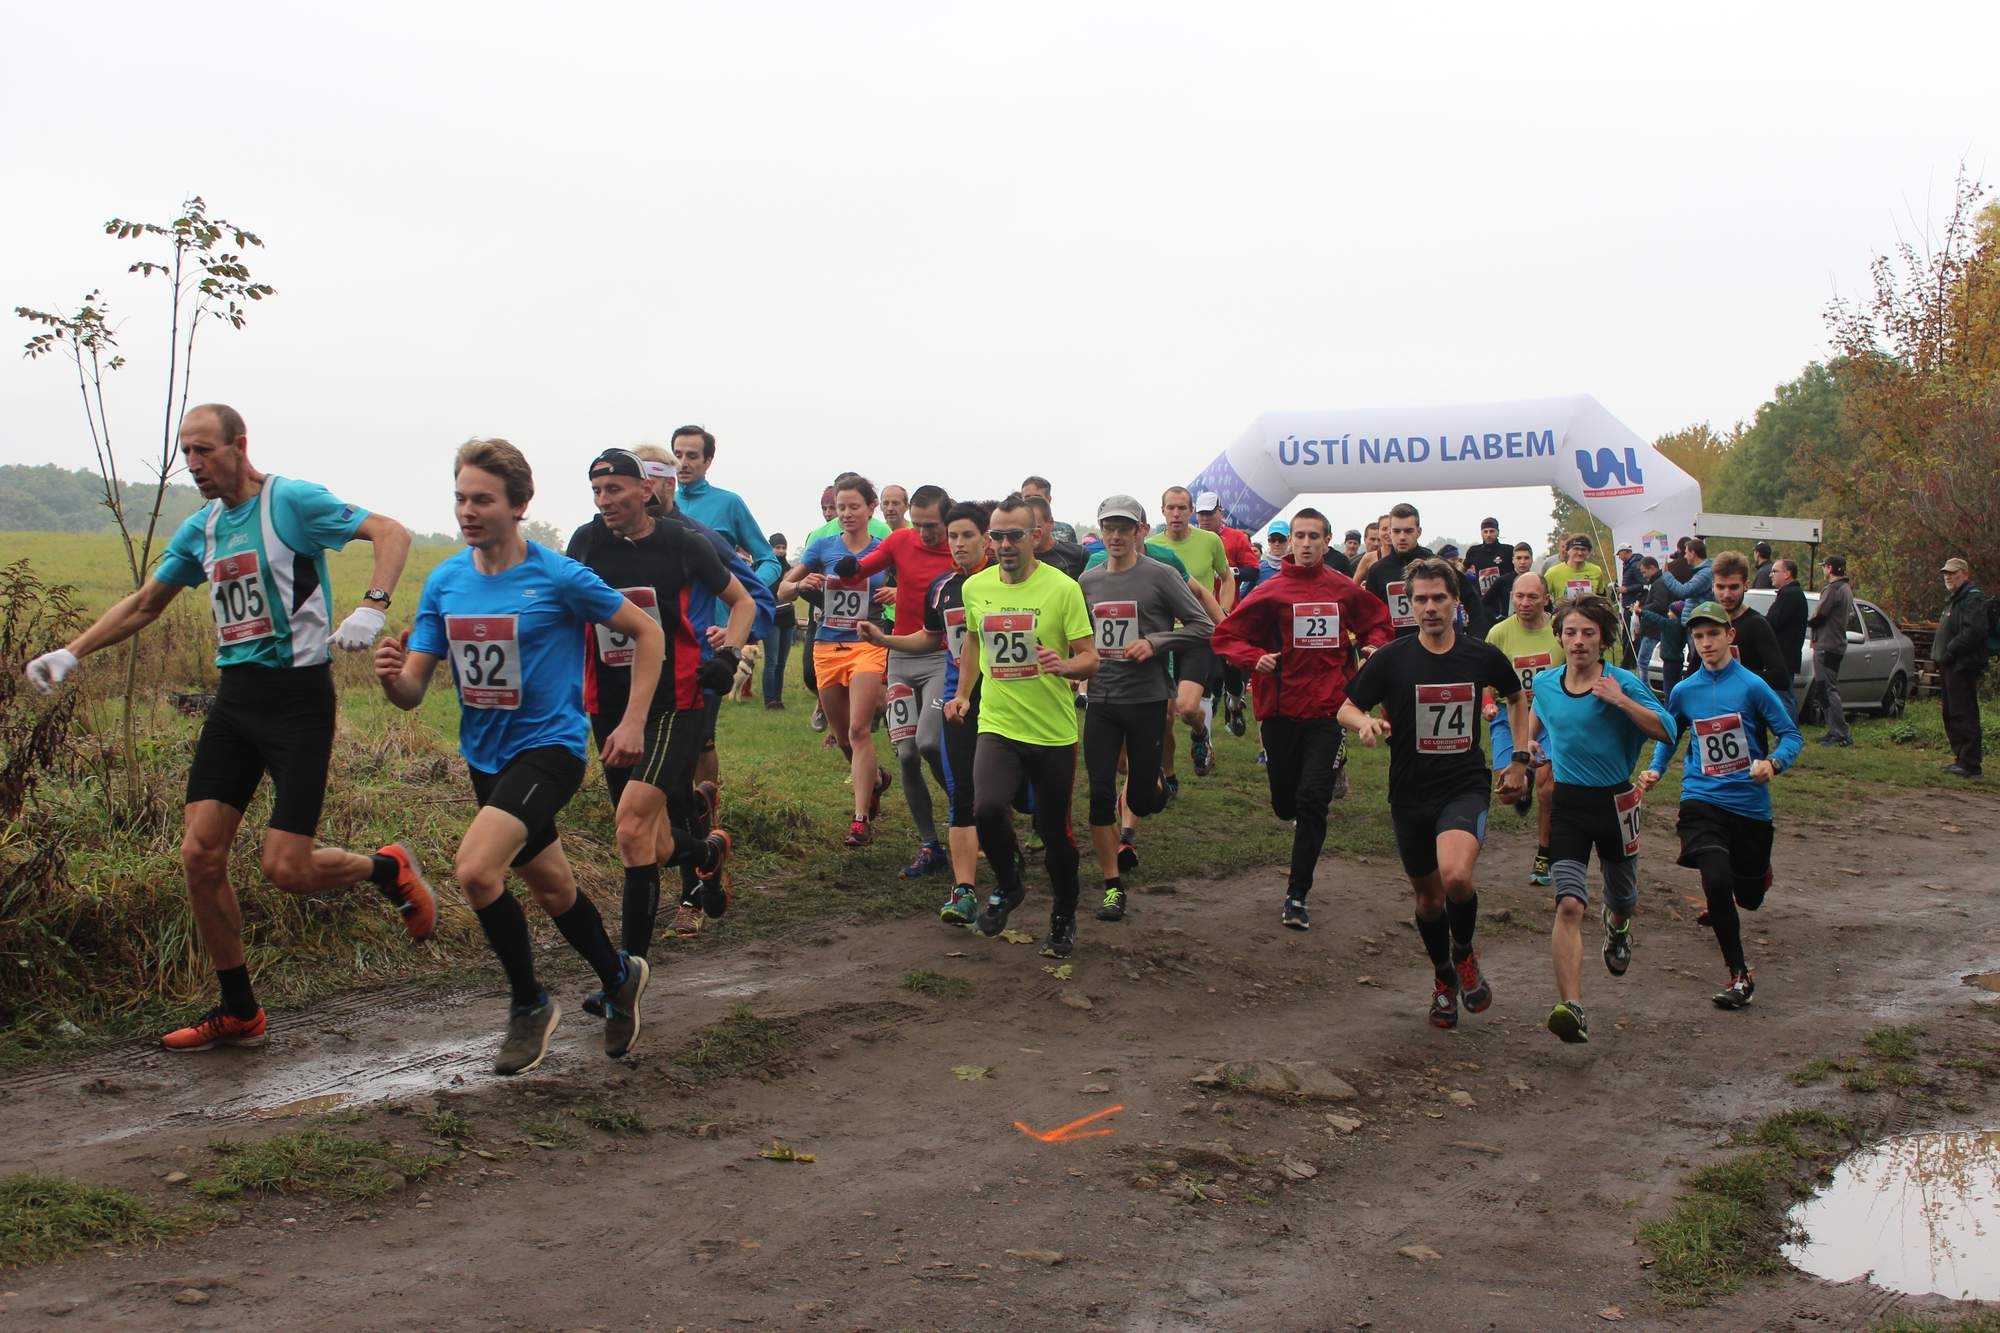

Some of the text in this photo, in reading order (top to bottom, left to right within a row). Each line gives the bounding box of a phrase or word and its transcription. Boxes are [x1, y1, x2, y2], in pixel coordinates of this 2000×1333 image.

[1279, 430, 1555, 466] ÚSTÍ NAD LABEM
[215, 577, 263, 624] 105
[833, 591, 860, 617] 29
[1102, 620, 1129, 647] 87
[1306, 618, 1327, 637] 23
[994, 632, 1028, 663] 25
[464, 644, 507, 686] 32
[1429, 705, 1465, 736] 74
[1706, 732, 1740, 762] 86
[1623, 806, 1640, 840] 10
